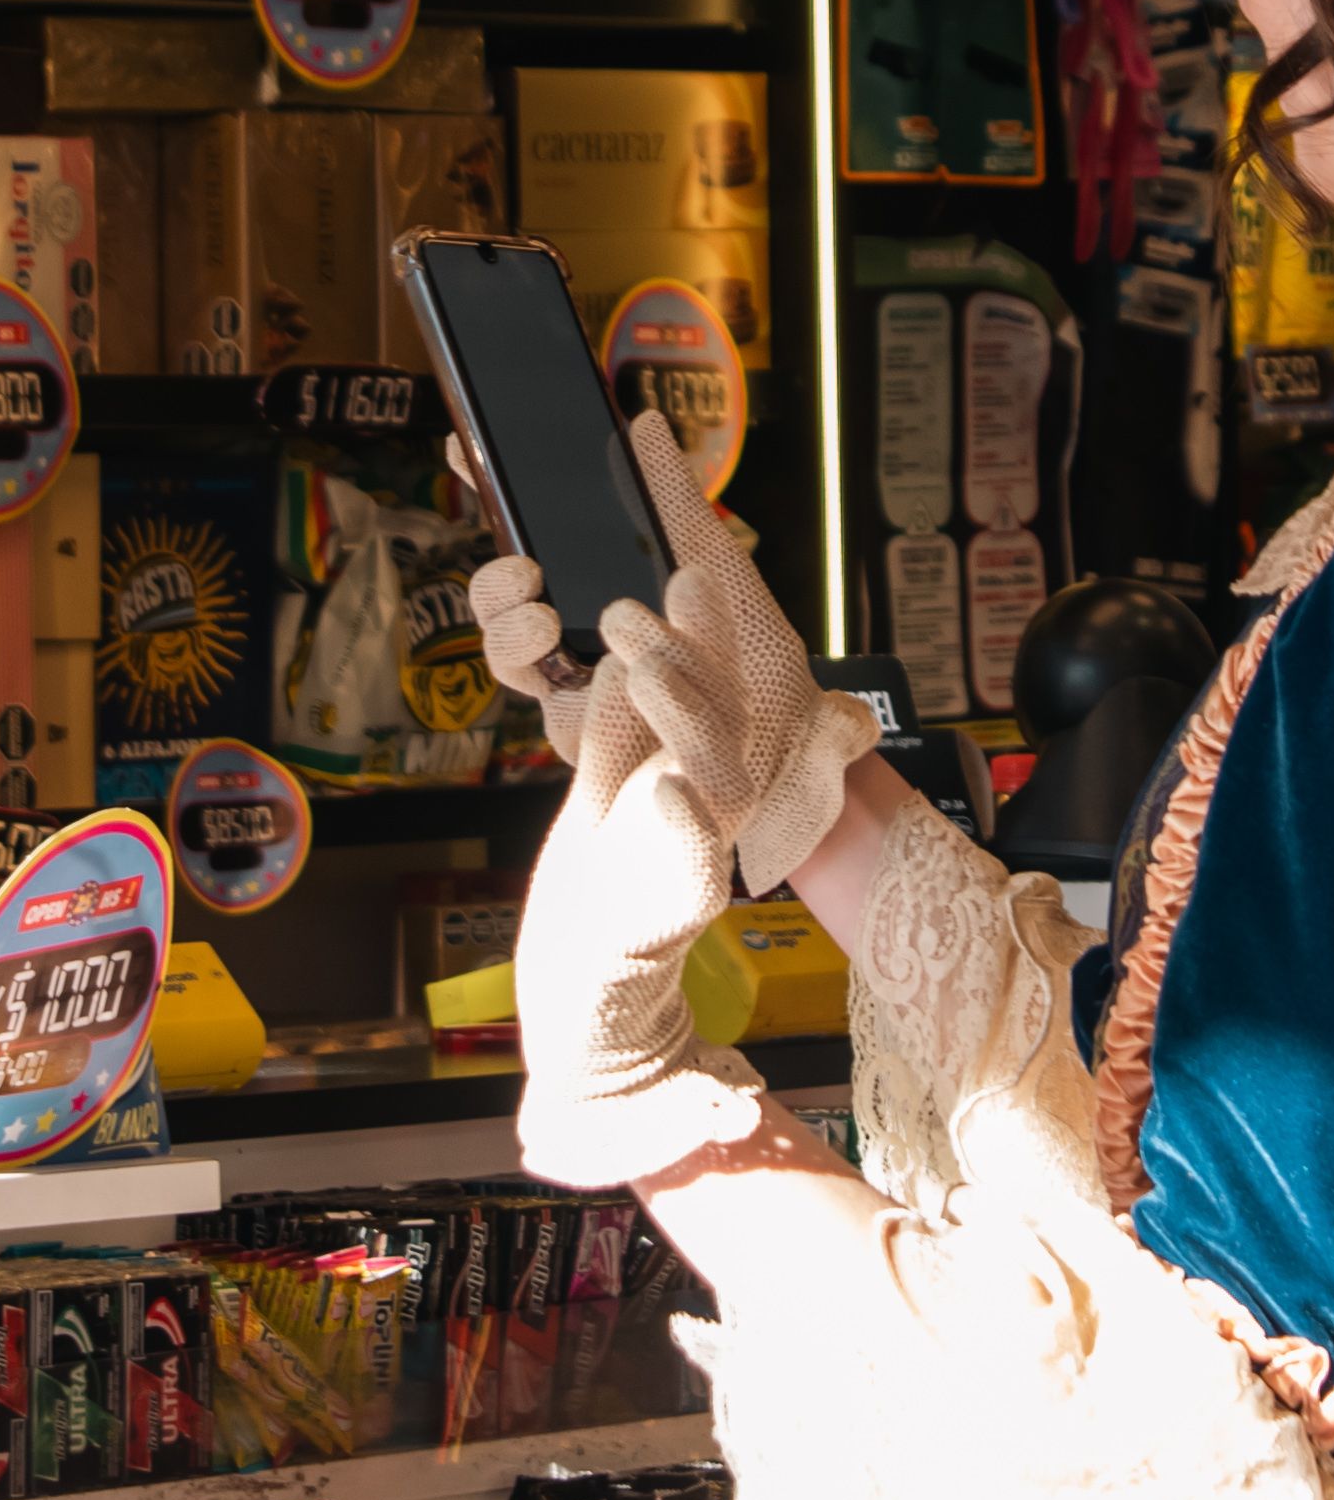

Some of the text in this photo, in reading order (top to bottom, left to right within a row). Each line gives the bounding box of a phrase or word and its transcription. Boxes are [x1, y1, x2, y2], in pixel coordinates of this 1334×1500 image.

[120, 564, 196, 631] RASTA
[23, 900, 70, 925] OPEN
[98, 889, 122, 910] HS
[69, 1362, 88, 1455] ULTRA
[158, 1354, 180, 1447] ULTRA
